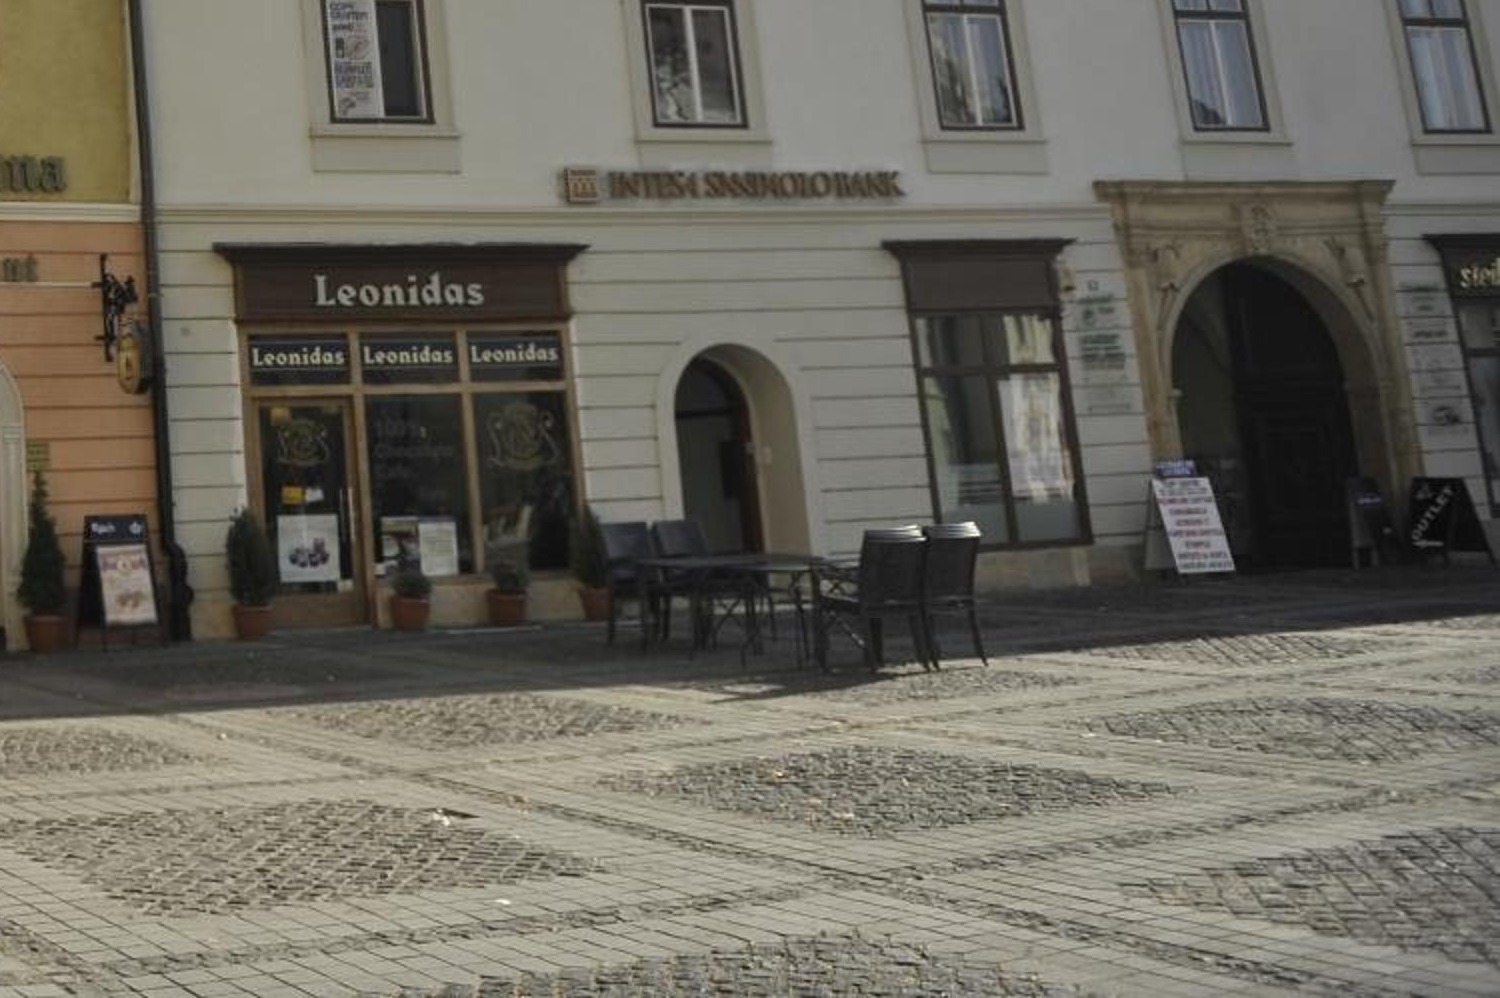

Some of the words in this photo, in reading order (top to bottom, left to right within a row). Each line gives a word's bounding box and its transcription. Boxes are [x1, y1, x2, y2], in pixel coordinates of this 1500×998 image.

[314, 271, 485, 307] Leonidas
[252, 346, 346, 367] Leonidas
[363, 345, 454, 366] Leonidas
[470, 343, 560, 364] Leonidas
[1411, 485, 1453, 543] OUTLET
